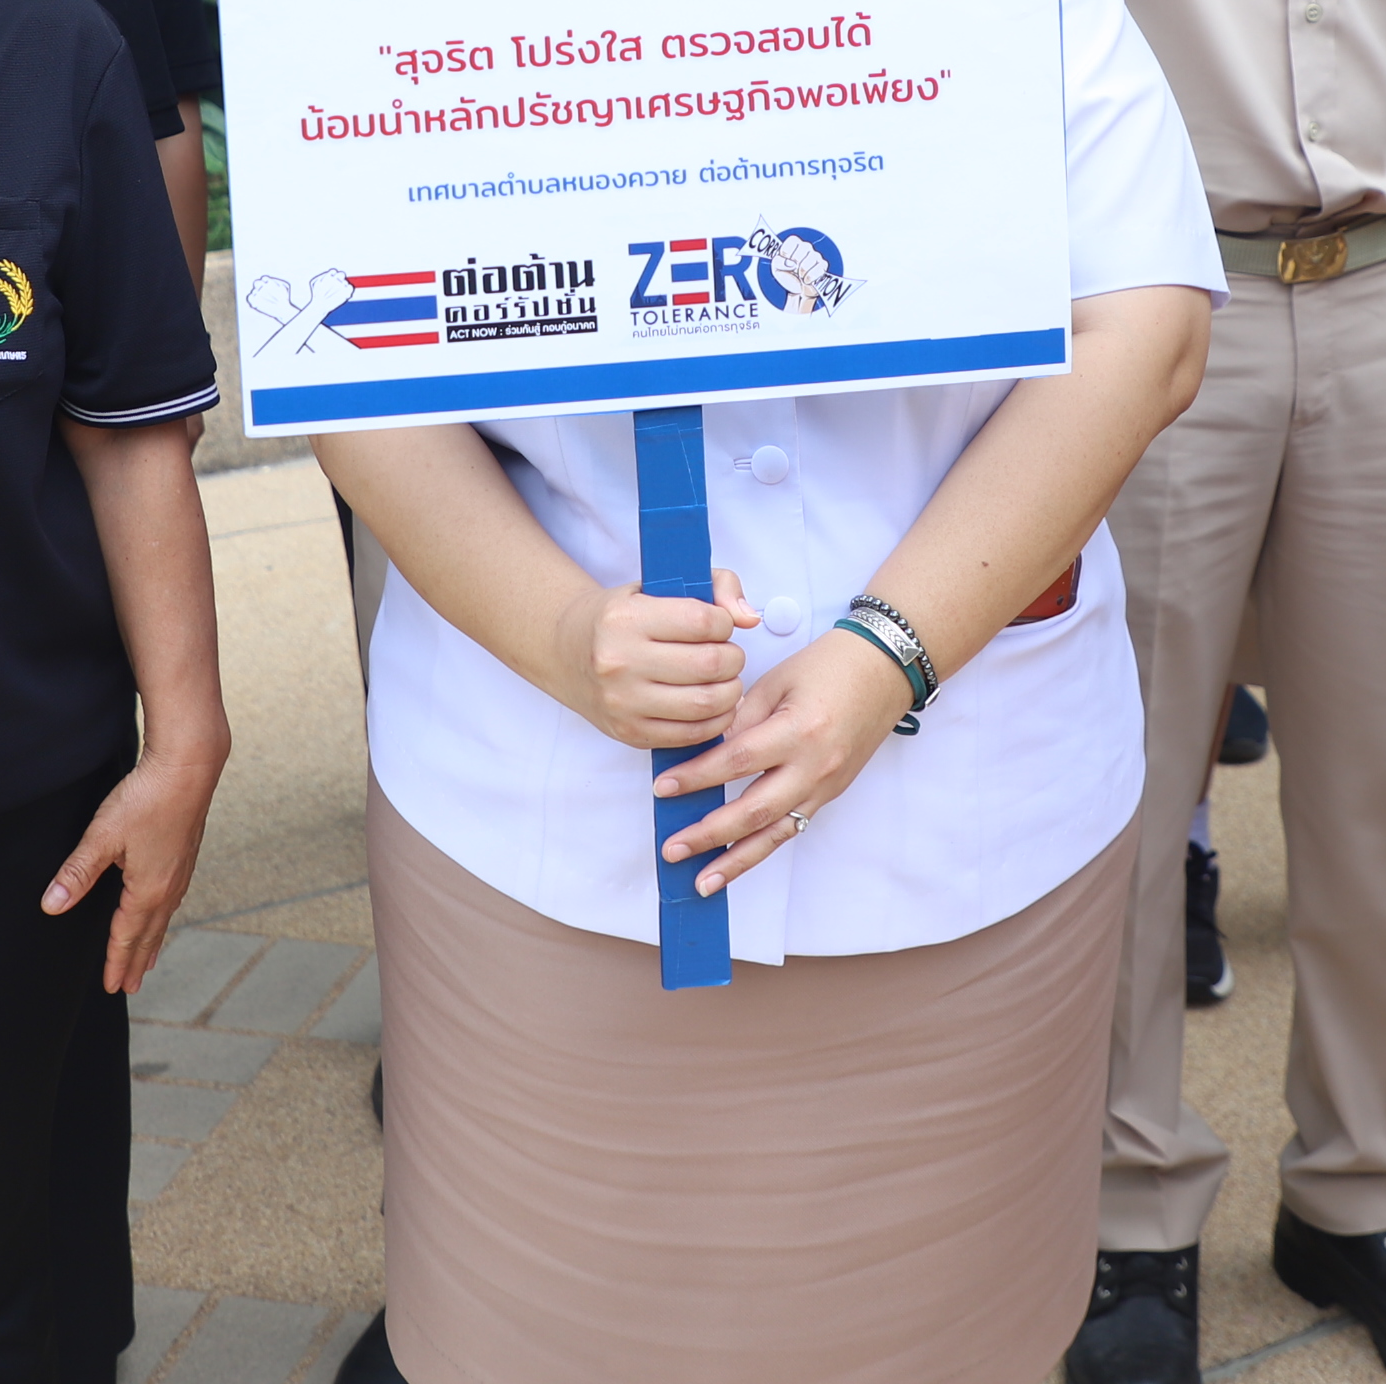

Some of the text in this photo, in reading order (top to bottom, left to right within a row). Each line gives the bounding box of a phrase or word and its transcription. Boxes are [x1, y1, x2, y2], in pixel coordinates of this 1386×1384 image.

[378, 11, 872, 86] "สุจริต โปร่งใส ตรวจสอบได้
[300, 67, 951, 142] น้อมนำหลักปรัชญาเศรษฐกิจพอเพียง"
[408, 150, 884, 203] เทศบาลตำบลหนองควาย ต่อต้านการทุจริต
[442, 253, 596, 297] ต่อต้าน
[627, 227, 845, 314] ZERO
[449, 328, 470, 340] ACT
[472, 326, 498, 338] NOW
[630, 302, 759, 327] TOLERANCE
[632, 319, 761, 339] คนไทยไม่ทนต่อการทุจริต
